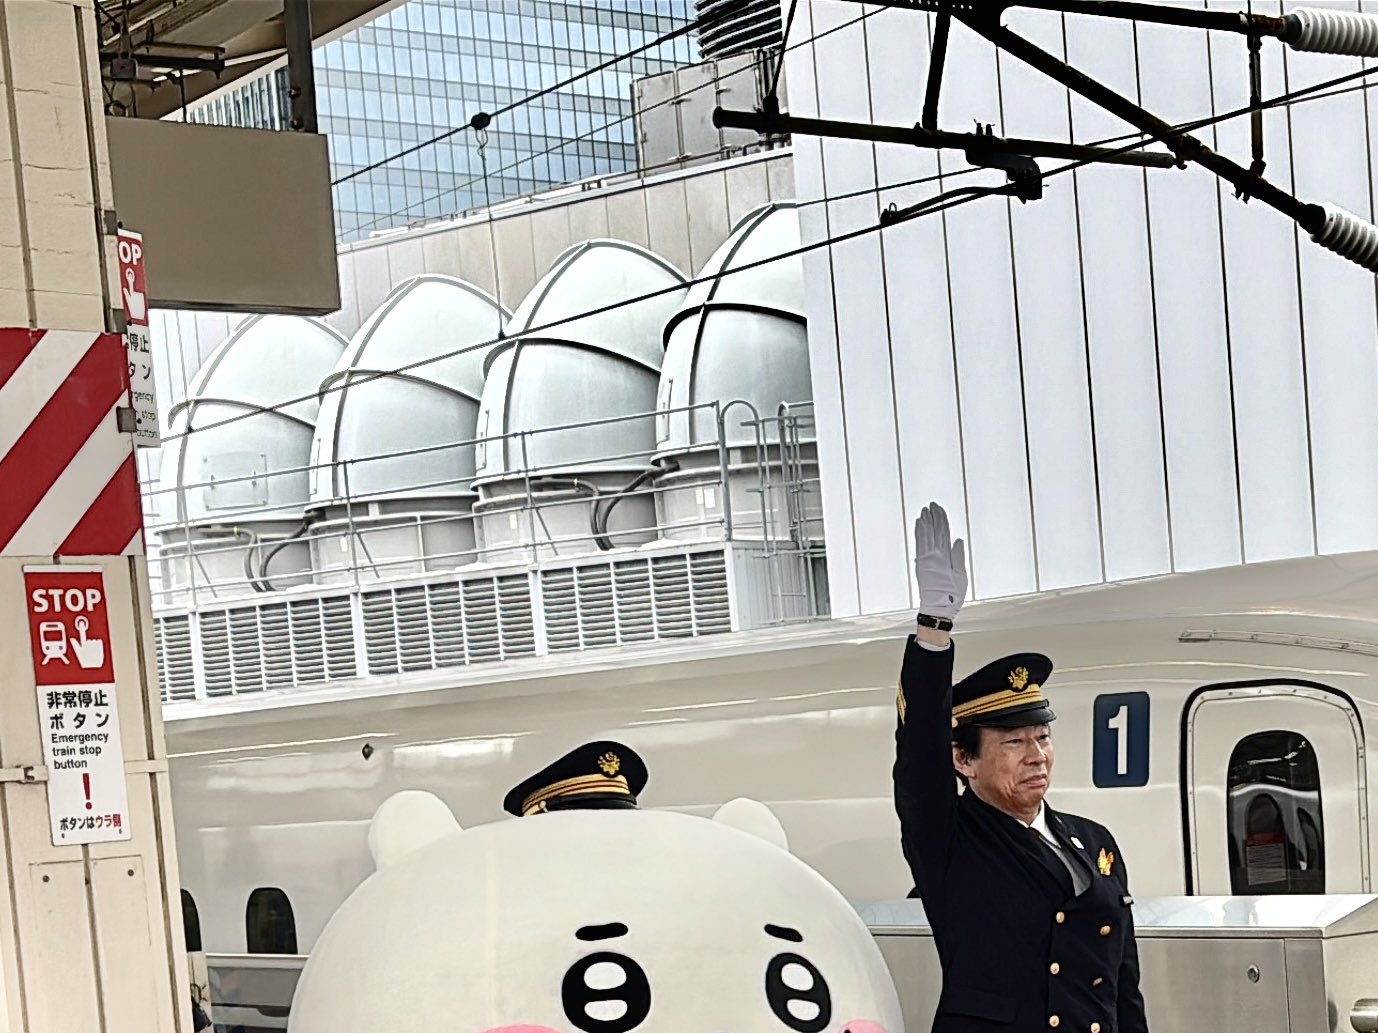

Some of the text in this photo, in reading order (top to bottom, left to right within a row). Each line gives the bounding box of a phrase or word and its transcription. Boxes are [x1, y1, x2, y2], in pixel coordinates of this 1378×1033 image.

[118, 241, 142, 265] OP
[129, 332, 150, 353] 停止
[32, 588, 101, 613] STOP
[46, 689, 109, 709] 非常停止
[50, 712, 110, 730] ボタン
[51, 732, 109, 744] Emergency
[1107, 705, 1128, 775] 1
[52, 745, 102, 756] train stop
[54, 760, 88, 770] button
